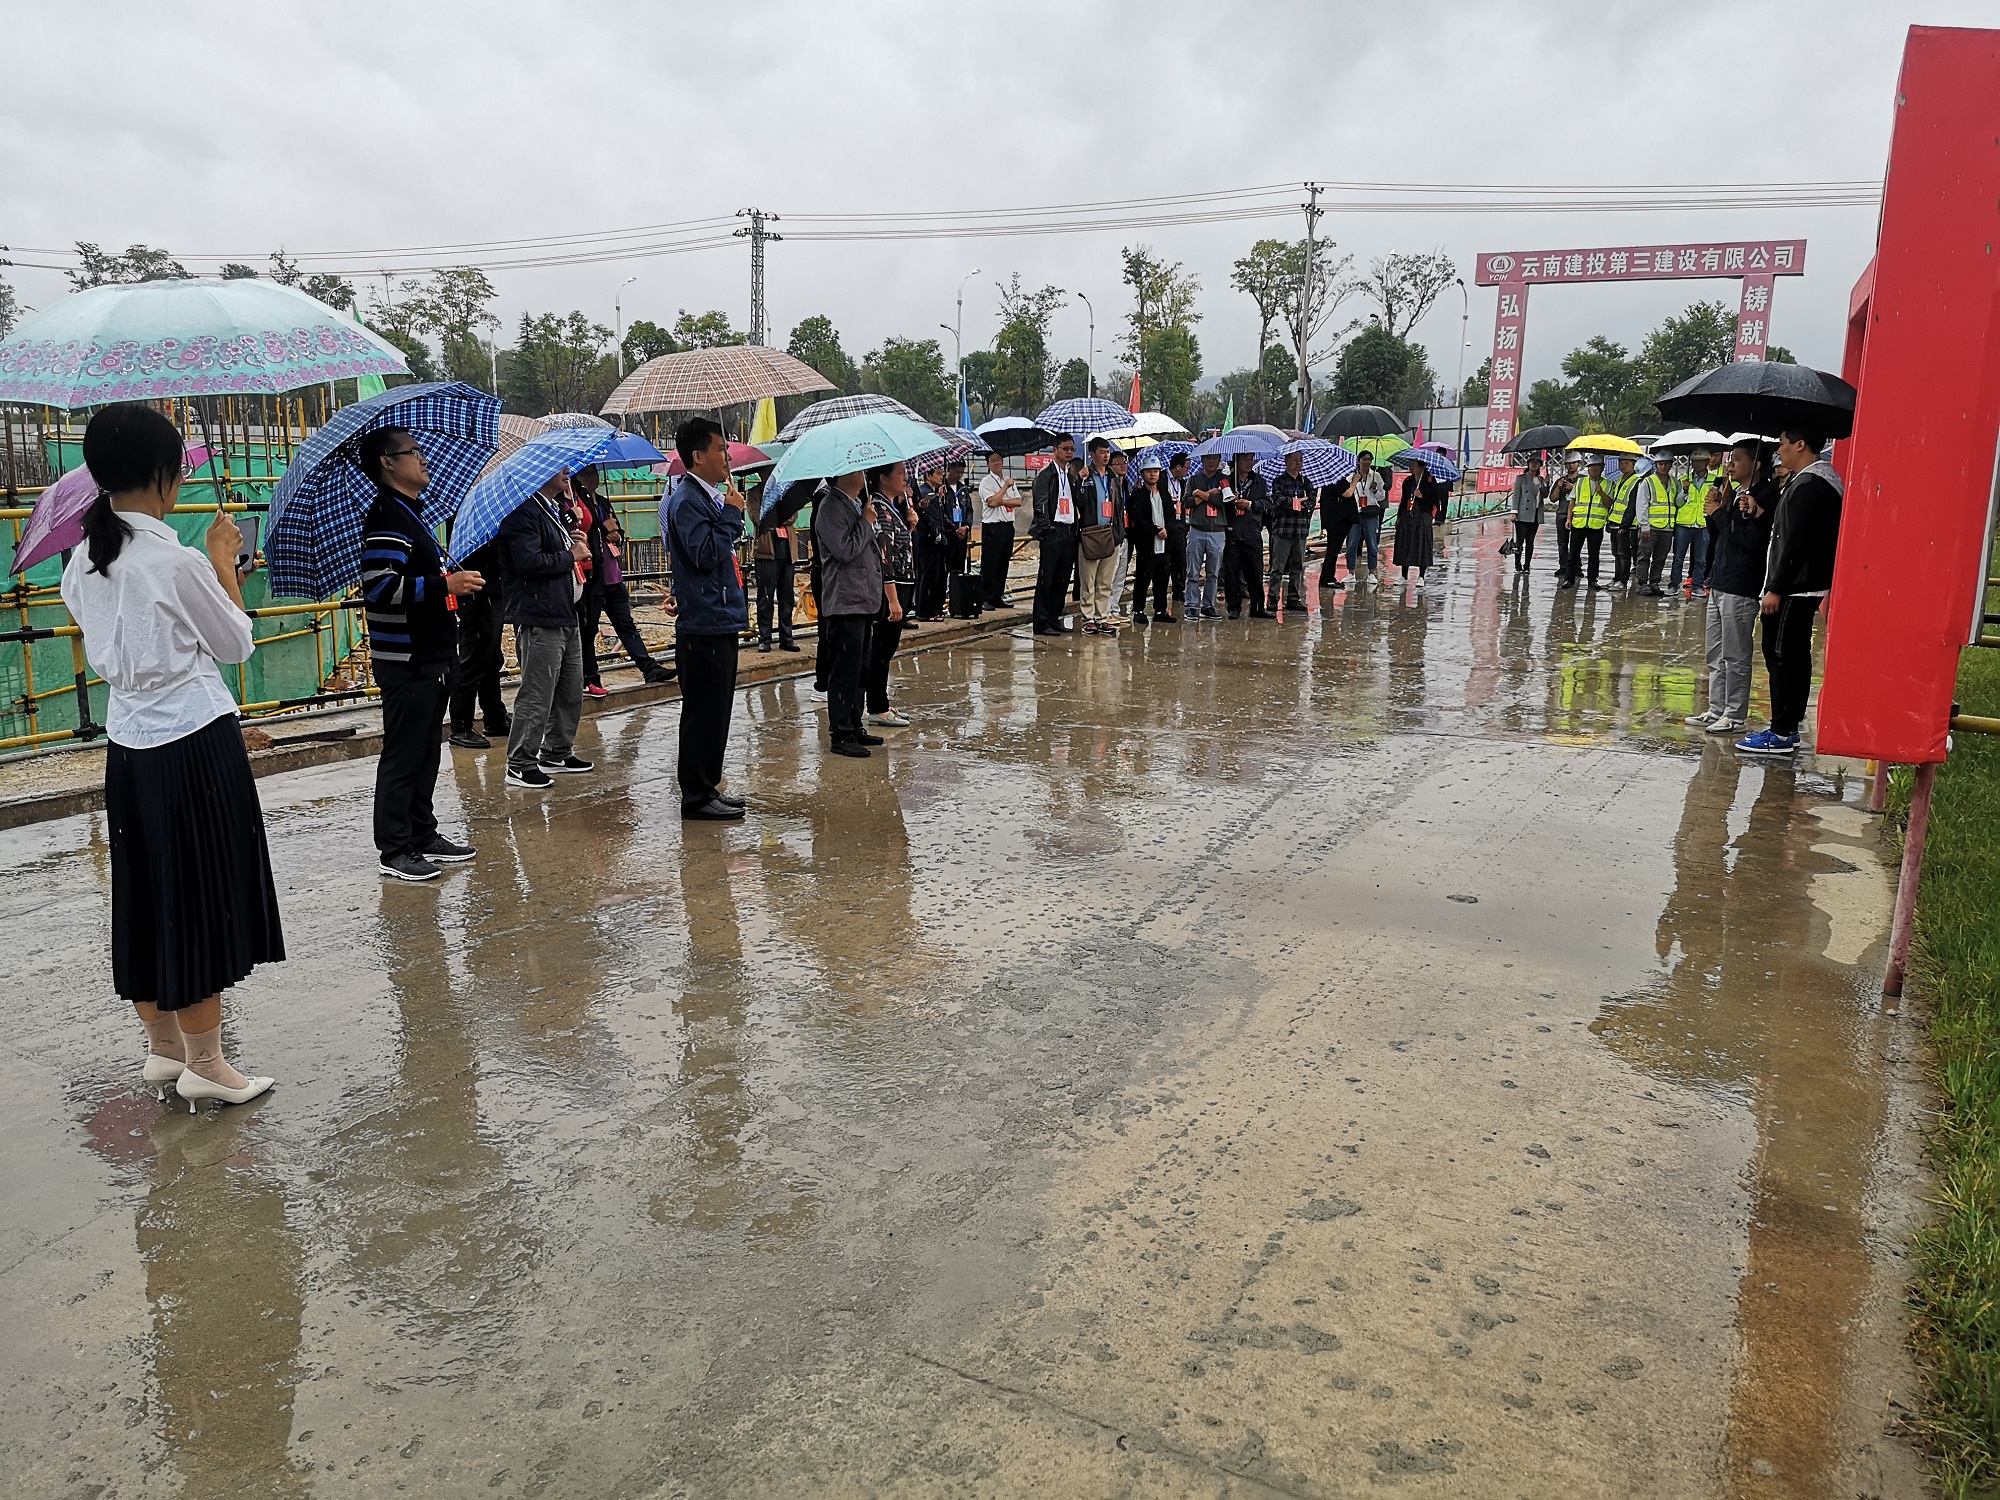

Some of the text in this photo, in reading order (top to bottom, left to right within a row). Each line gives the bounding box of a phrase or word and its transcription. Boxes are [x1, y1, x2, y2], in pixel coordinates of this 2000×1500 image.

[1521, 245, 1795, 278] 云南建投第三建设有限公司
[1485, 294, 1520, 468] 弘扬铁军精神
